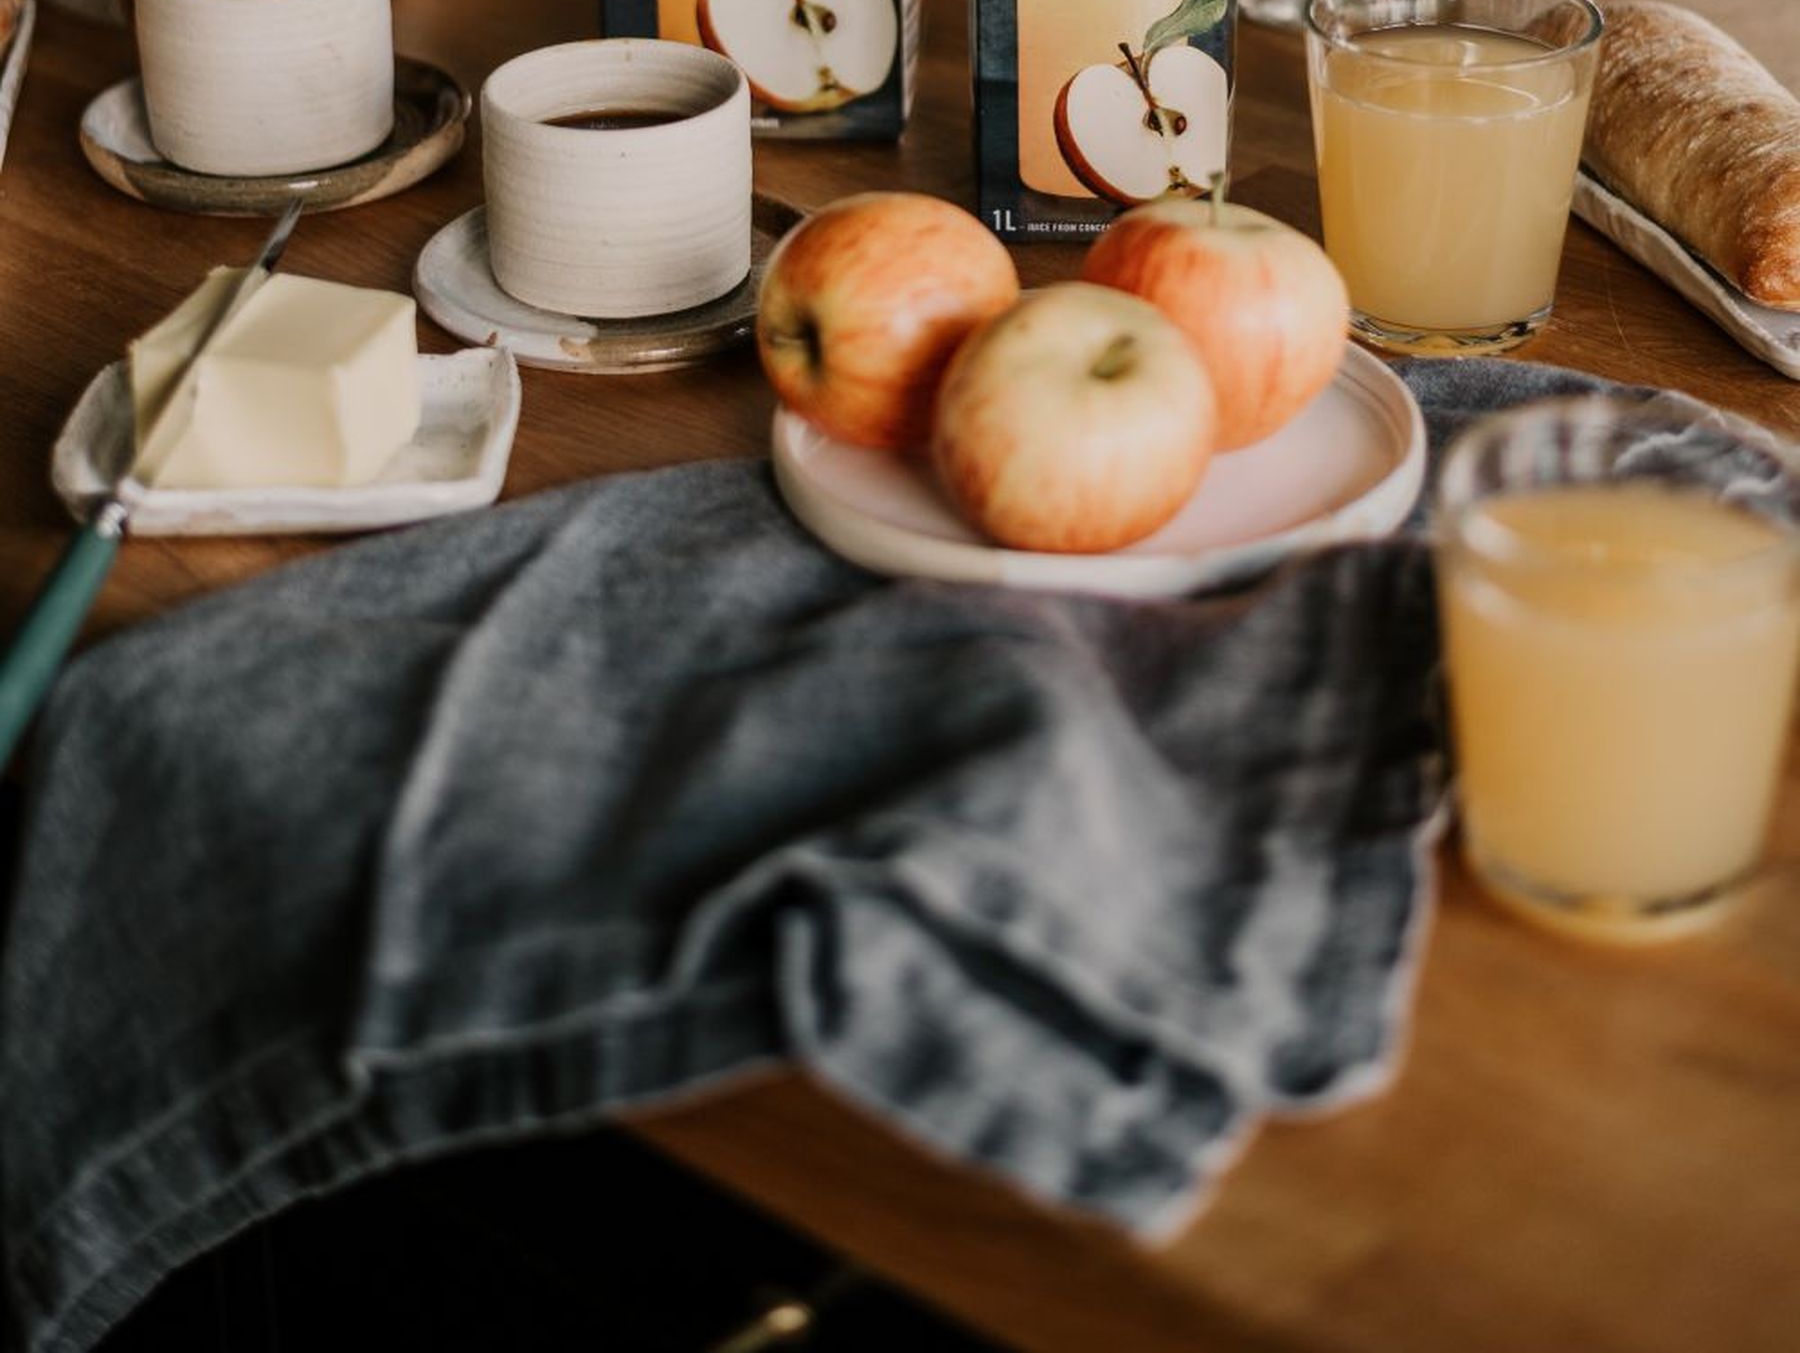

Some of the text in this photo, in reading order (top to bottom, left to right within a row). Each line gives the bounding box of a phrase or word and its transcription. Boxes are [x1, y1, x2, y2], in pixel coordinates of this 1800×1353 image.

[992, 209, 1017, 232] 1L
[1027, 223, 1051, 232] JUICE
[1052, 223, 1077, 232] FROM
